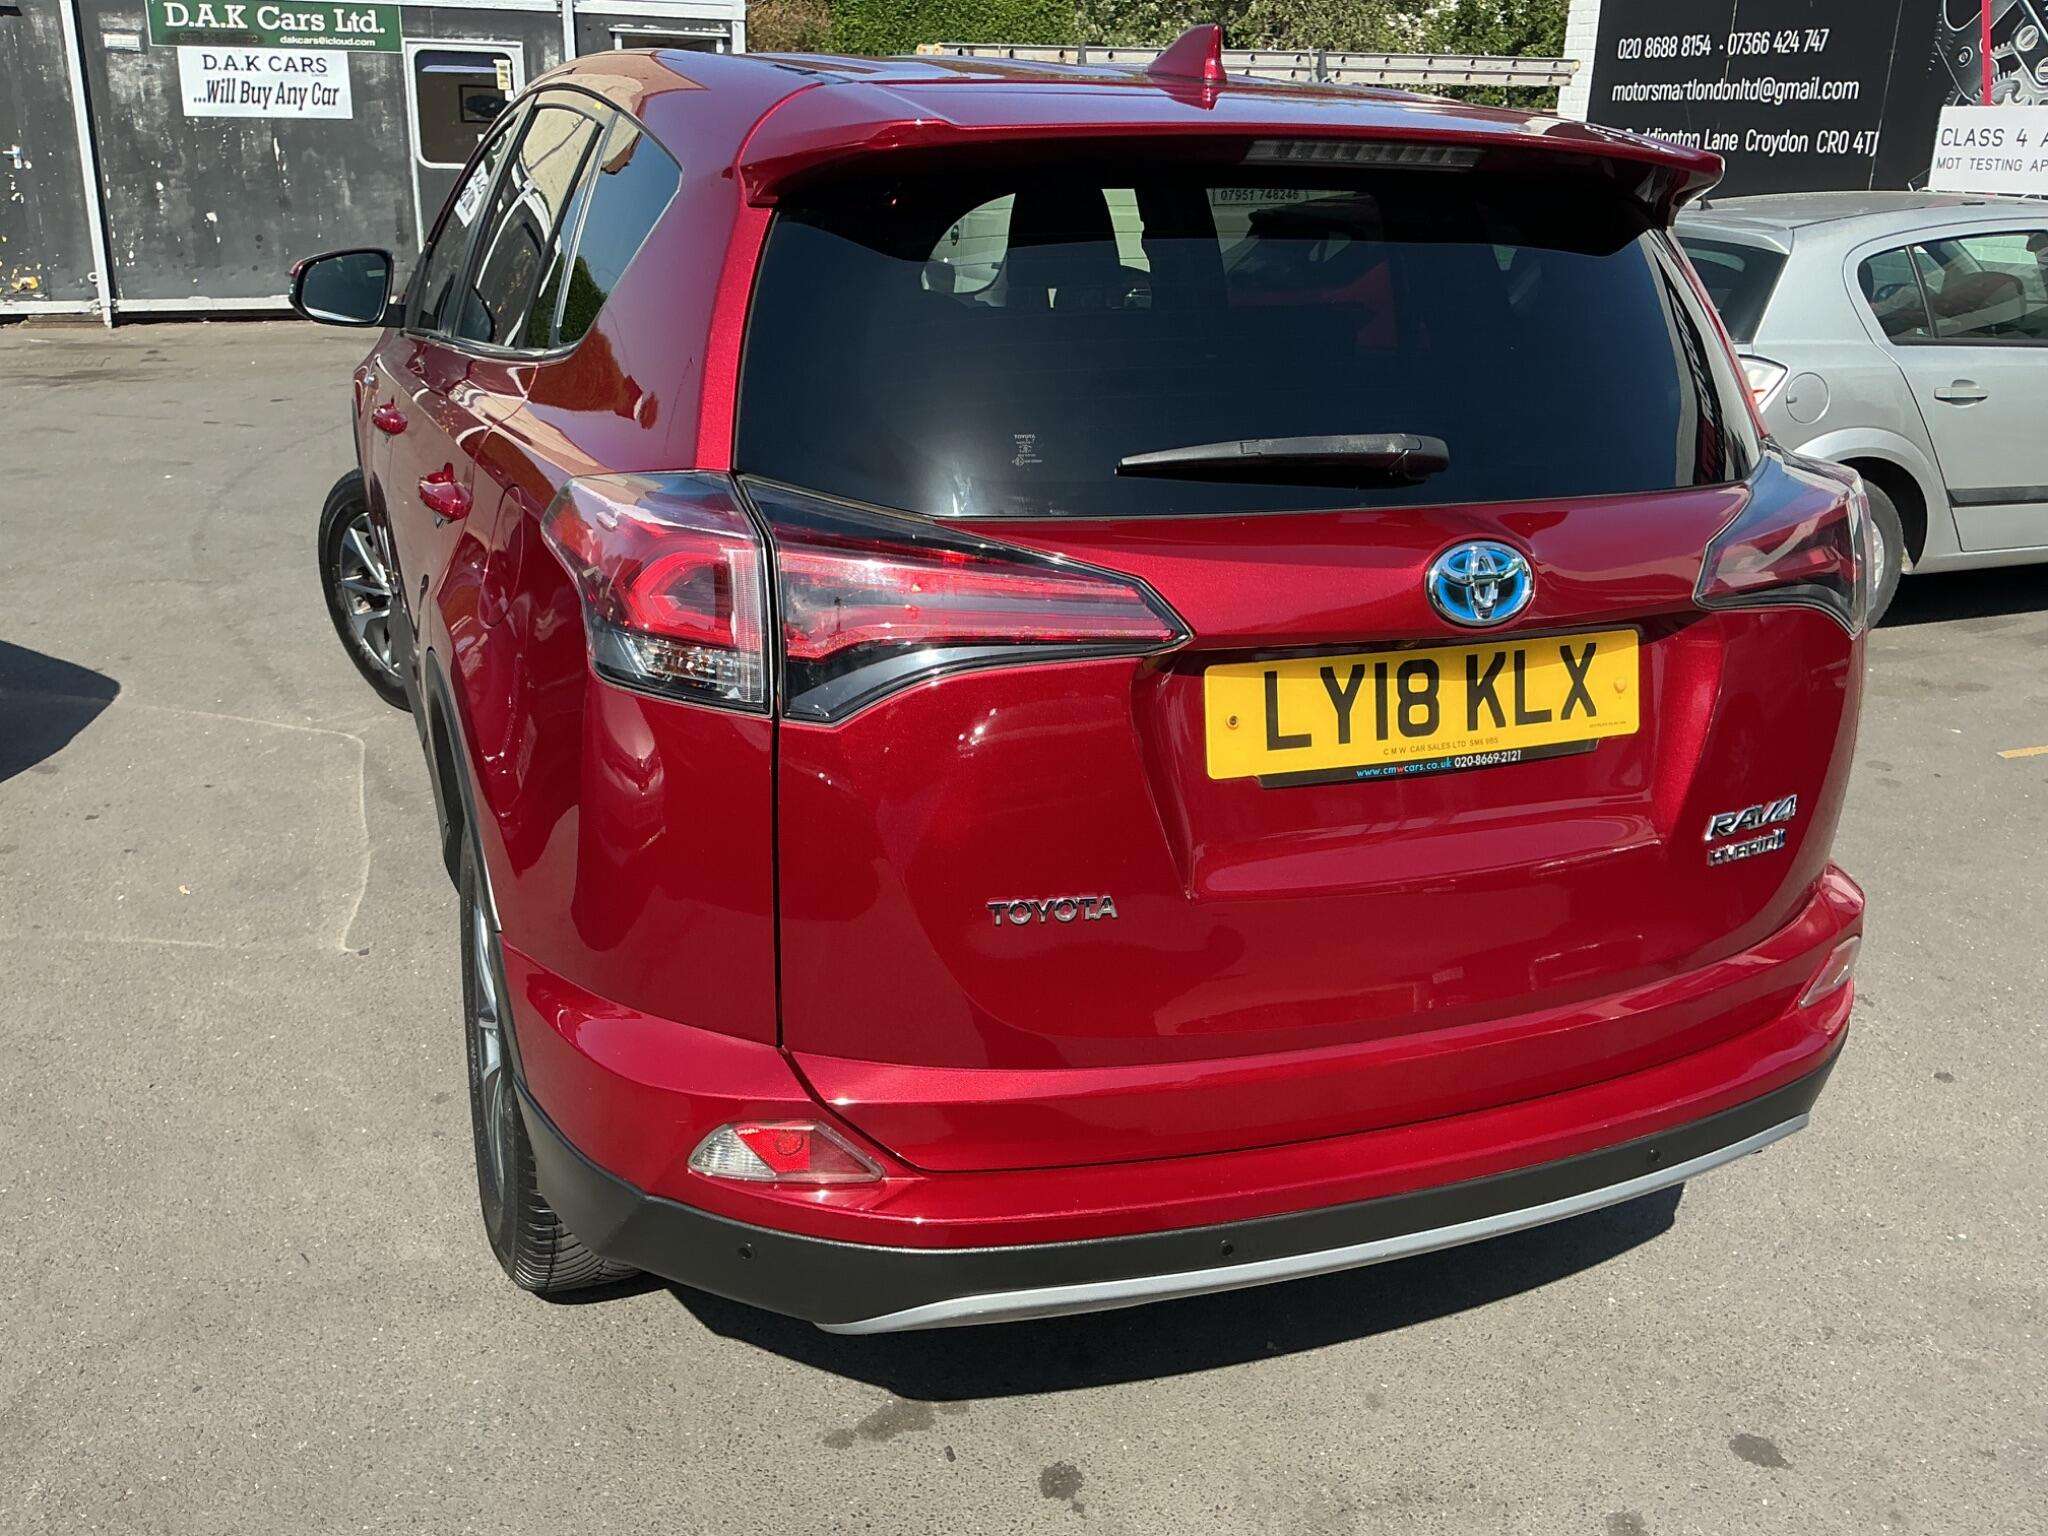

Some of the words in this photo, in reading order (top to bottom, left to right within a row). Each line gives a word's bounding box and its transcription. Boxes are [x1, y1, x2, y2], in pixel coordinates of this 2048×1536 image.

[164, 2, 248, 29] D.A.K
[256, 6, 326, 32] Cars
[333, 8, 386, 34] Ltd.
[280, 35, 376, 46] dakcars@icloud.com
[1617, 38, 1642, 60] 020
[1644, 36, 1679, 59] 8688
[1681, 34, 1712, 57] 8154
[1727, 31, 1771, 56] 07366
[1773, 30, 1800, 54] 424
[1803, 28, 1830, 52] 747
[202, 54, 261, 71] D.A.K
[268, 56, 328, 73] CARS
[240, 80, 273, 110] Buy
[275, 81, 309, 111] Any
[311, 81, 340, 106] Car
[1611, 76, 1860, 106] motorsmartlondonltd@gmail.com
[1703, 128, 1739, 151] Lane
[1744, 128, 1809, 157] Croydon
[1852, 130, 1880, 157] 4TJ
[1941, 128, 2005, 147] CLASS
[2016, 128, 2028, 147] 4
[1936, 157, 1962, 170] MOT
[1970, 157, 2023, 172] TESTING
[1264, 658, 1440, 751] LY18
[1466, 642, 1597, 731] KLX
[1410, 744, 1426, 753] CAR
[1426, 742, 1451, 752] SALES
[1452, 740, 1467, 750] LTD
[1356, 758, 1452, 778] www.cmwcars.co.uk
[1454, 750, 1522, 768] 020-8669-2121
[1703, 794, 1798, 841] RAV4
[986, 894, 1119, 926] TOYOTA
